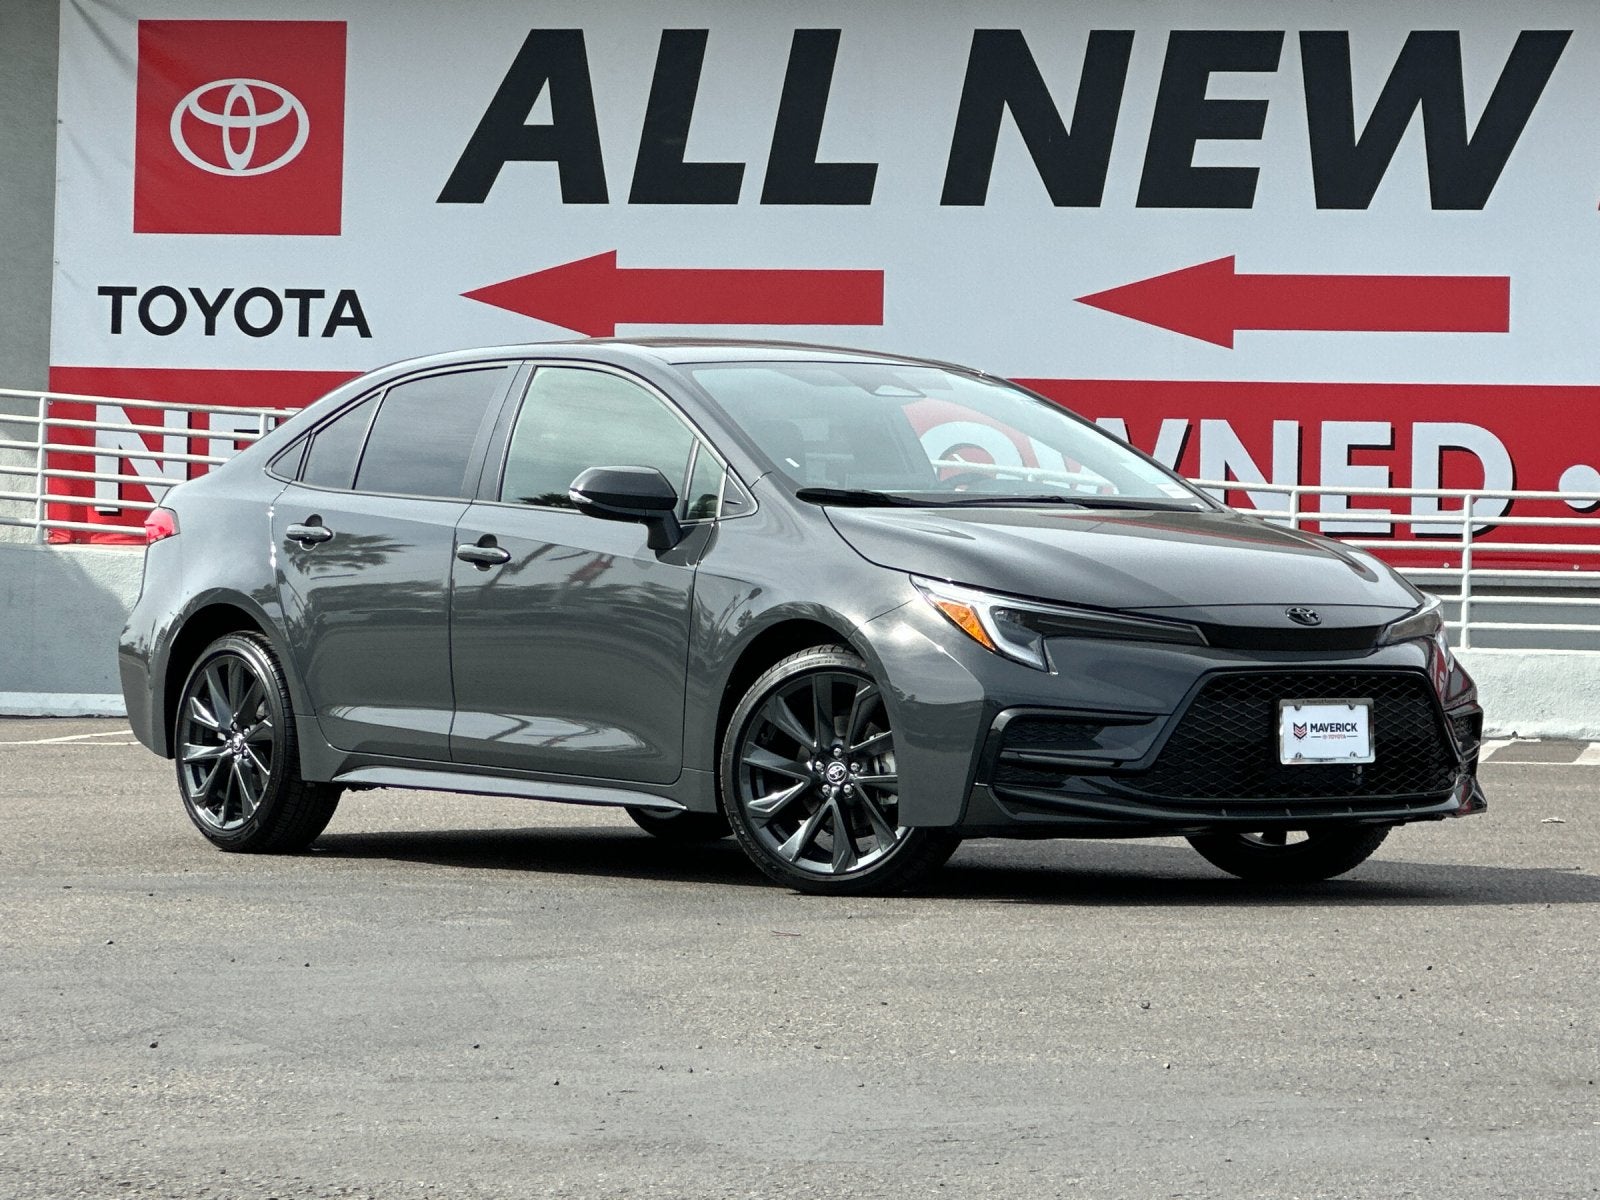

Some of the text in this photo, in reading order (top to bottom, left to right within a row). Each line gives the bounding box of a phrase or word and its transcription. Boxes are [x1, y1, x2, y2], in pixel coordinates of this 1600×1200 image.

[436, 28, 1574, 211] ALL NEW
[97, 285, 373, 338] TOYOTA
[1309, 722, 1358, 733] MAVERICK
